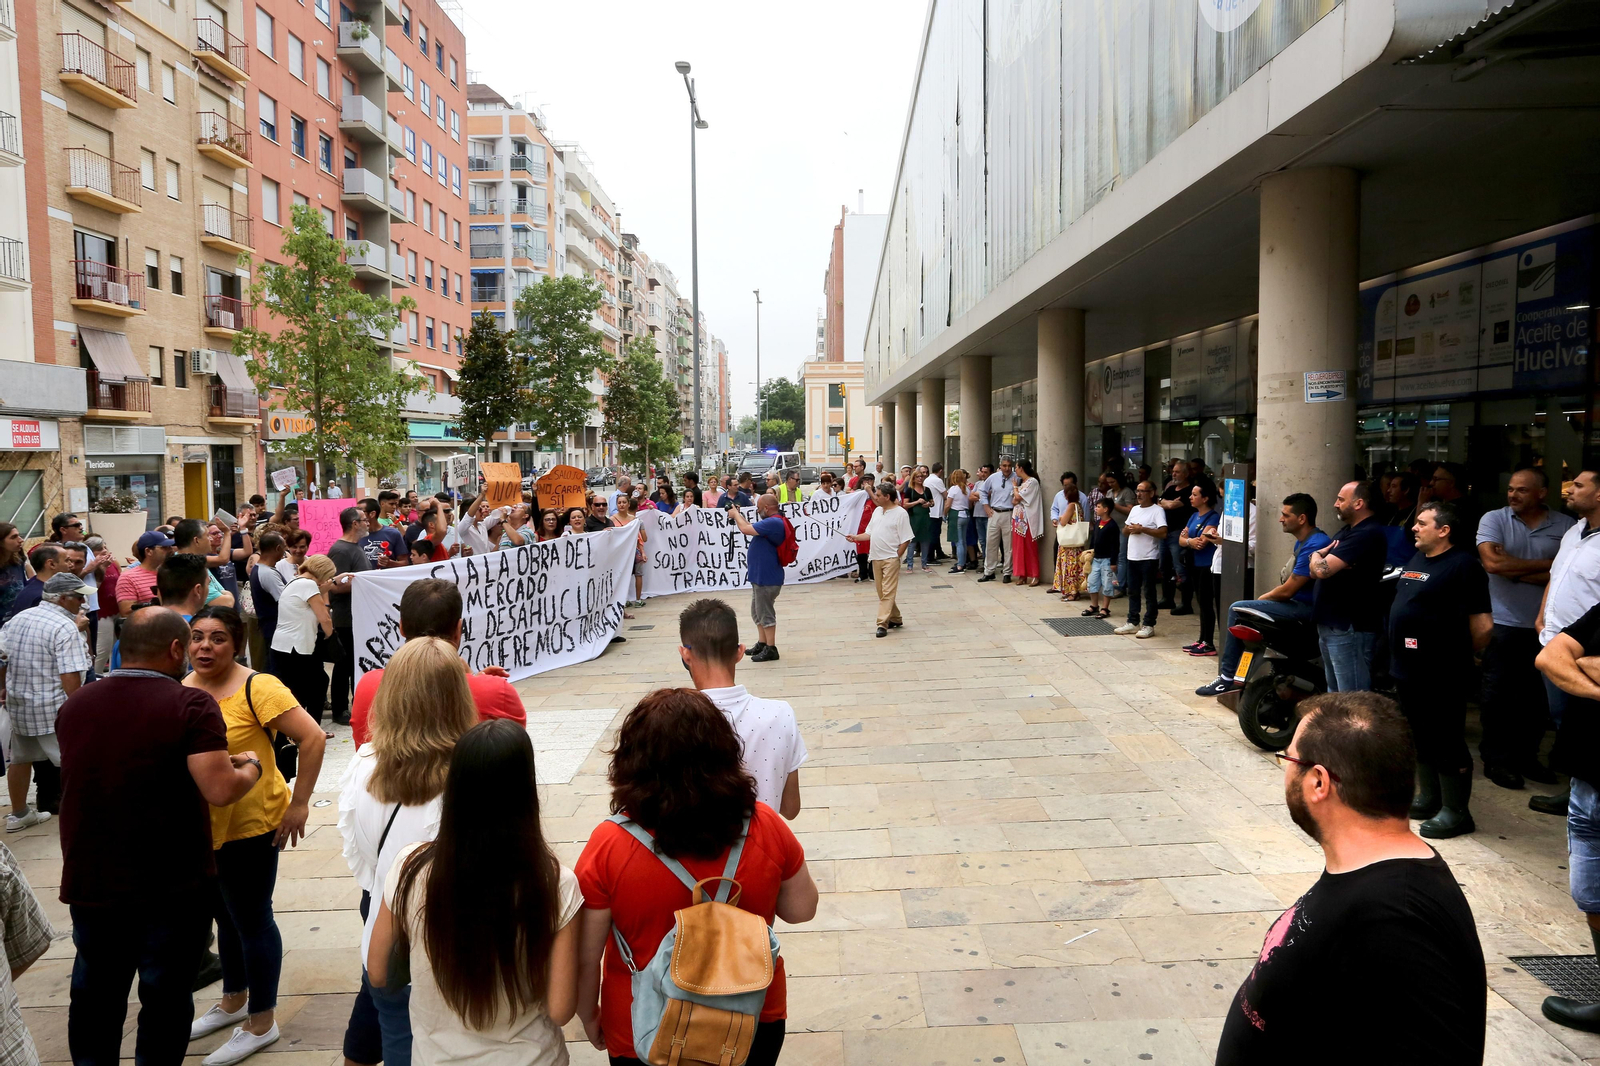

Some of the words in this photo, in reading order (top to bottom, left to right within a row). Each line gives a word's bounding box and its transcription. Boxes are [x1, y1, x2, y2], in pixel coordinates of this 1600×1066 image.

[1516, 307, 1574, 323] Cooperativas
[1516, 322, 1561, 345] Aceite
[1566, 316, 1588, 339] de
[1515, 341, 1587, 373] Huelva
[1400, 376, 1472, 391] www.aceitehuelva.com
[12, 424, 19, 433] SE
[20, 424, 39, 433] ALQUILA
[13, 436, 22, 444] 670
[493, 481, 517, 502] NO!
[554, 484, 582, 495] CARPA
[675, 511, 692, 529] LA
[778, 497, 840, 520] ERCADO
[668, 533, 689, 551] NO
[698, 531, 715, 546] AL
[517, 542, 560, 576] OBRA
[566, 538, 596, 570] DEL
[799, 553, 840, 577] CARPA
[467, 573, 548, 613] MERCADO
[475, 619, 576, 673] QUEREMOS
